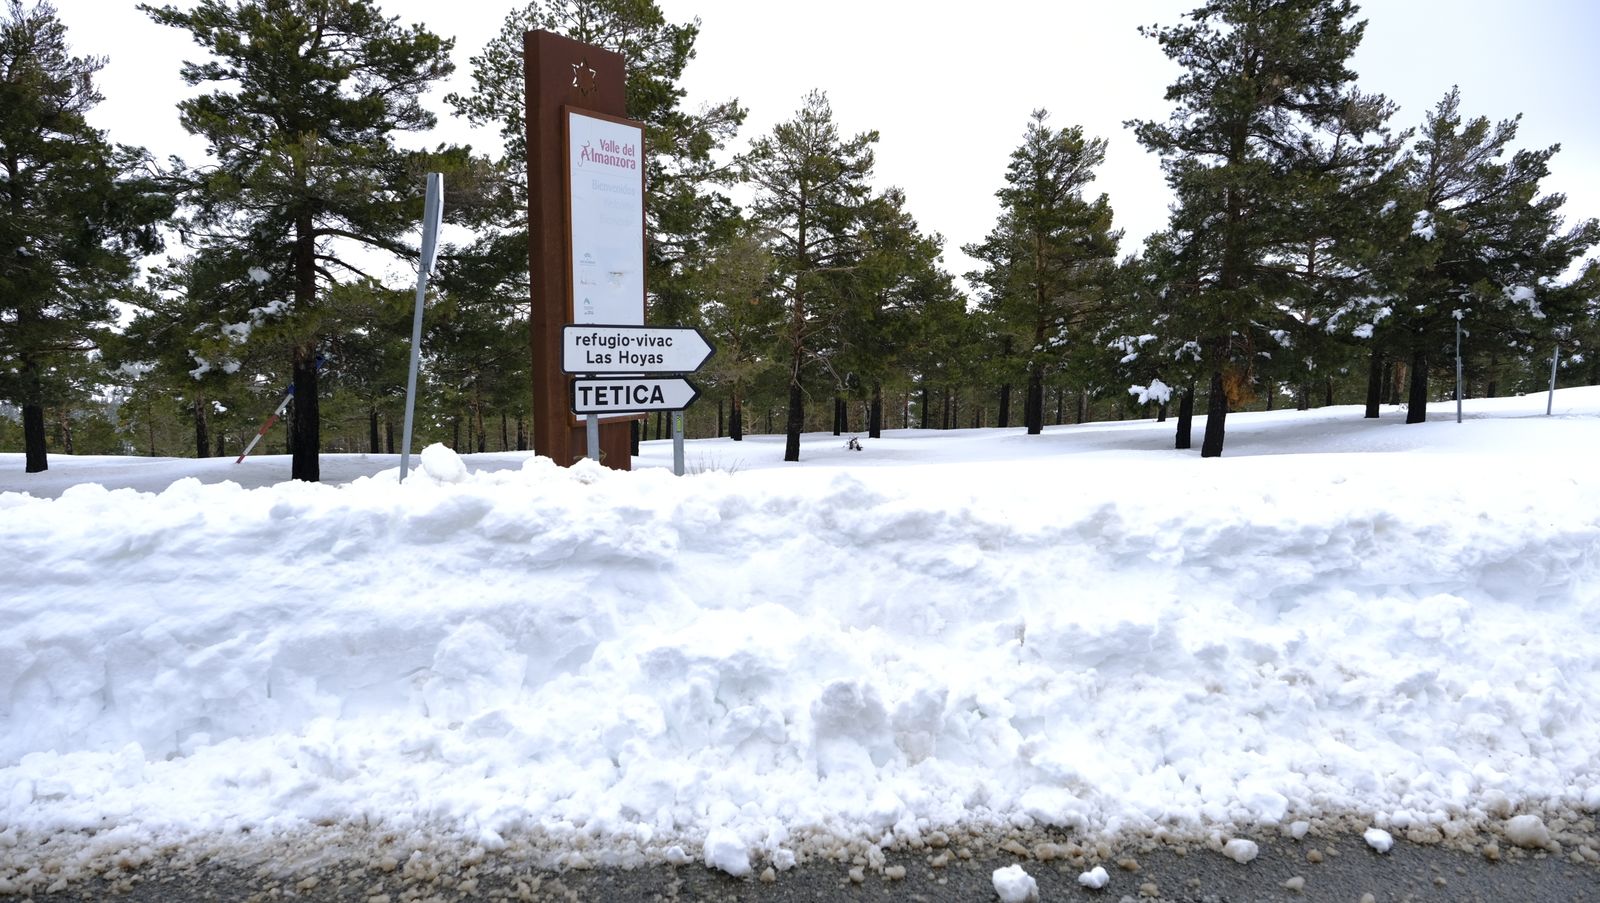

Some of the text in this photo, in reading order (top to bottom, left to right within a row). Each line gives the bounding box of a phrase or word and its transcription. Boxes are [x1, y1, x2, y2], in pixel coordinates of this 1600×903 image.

[577, 140, 636, 170] Almanzora
[599, 138, 635, 157] Valle del
[575, 332, 673, 349] refugio-vivac
[586, 350, 664, 366] Las Hoyas
[578, 384, 665, 406] TETICA
